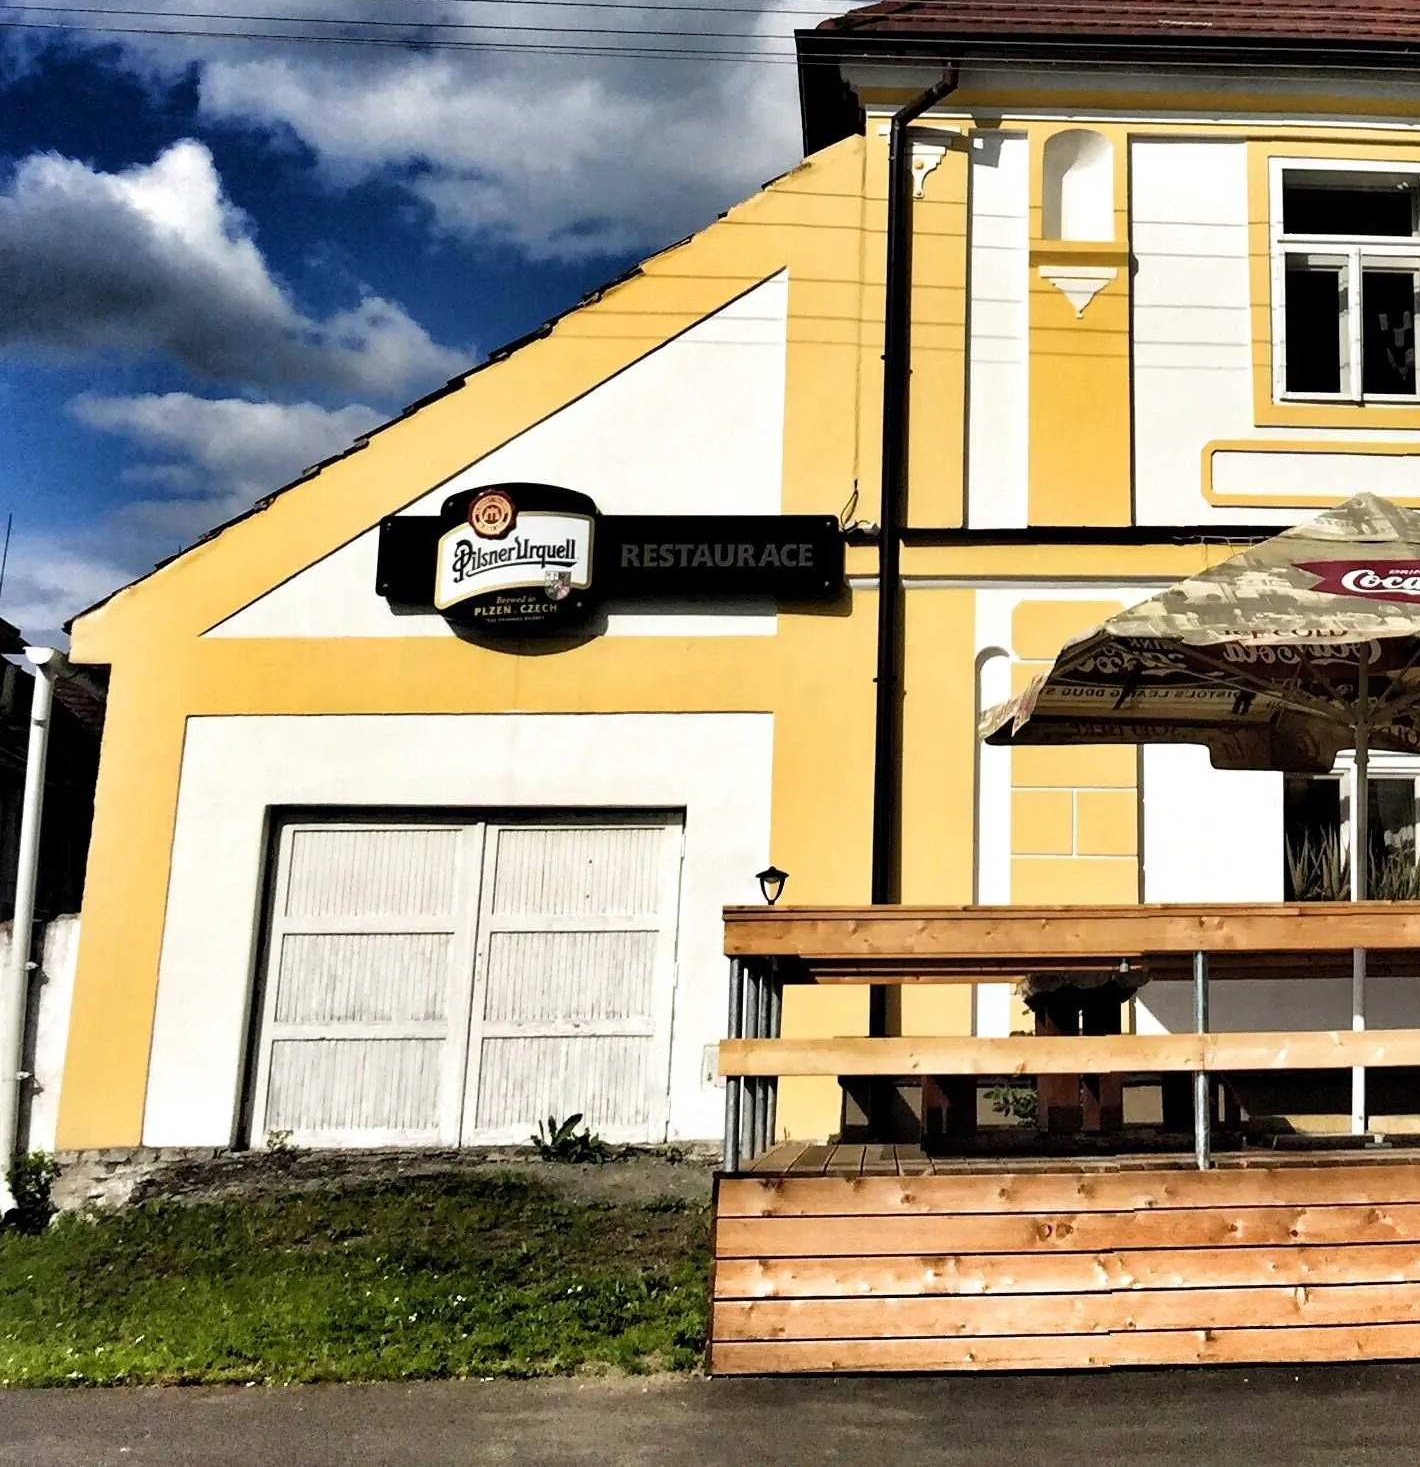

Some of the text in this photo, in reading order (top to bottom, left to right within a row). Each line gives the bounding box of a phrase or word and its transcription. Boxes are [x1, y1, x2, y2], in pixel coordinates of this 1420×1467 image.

[452, 536, 576, 583] Pilsner Urquell
[620, 543, 814, 568] RESTAURACE
[520, 604, 558, 614] CZECH
